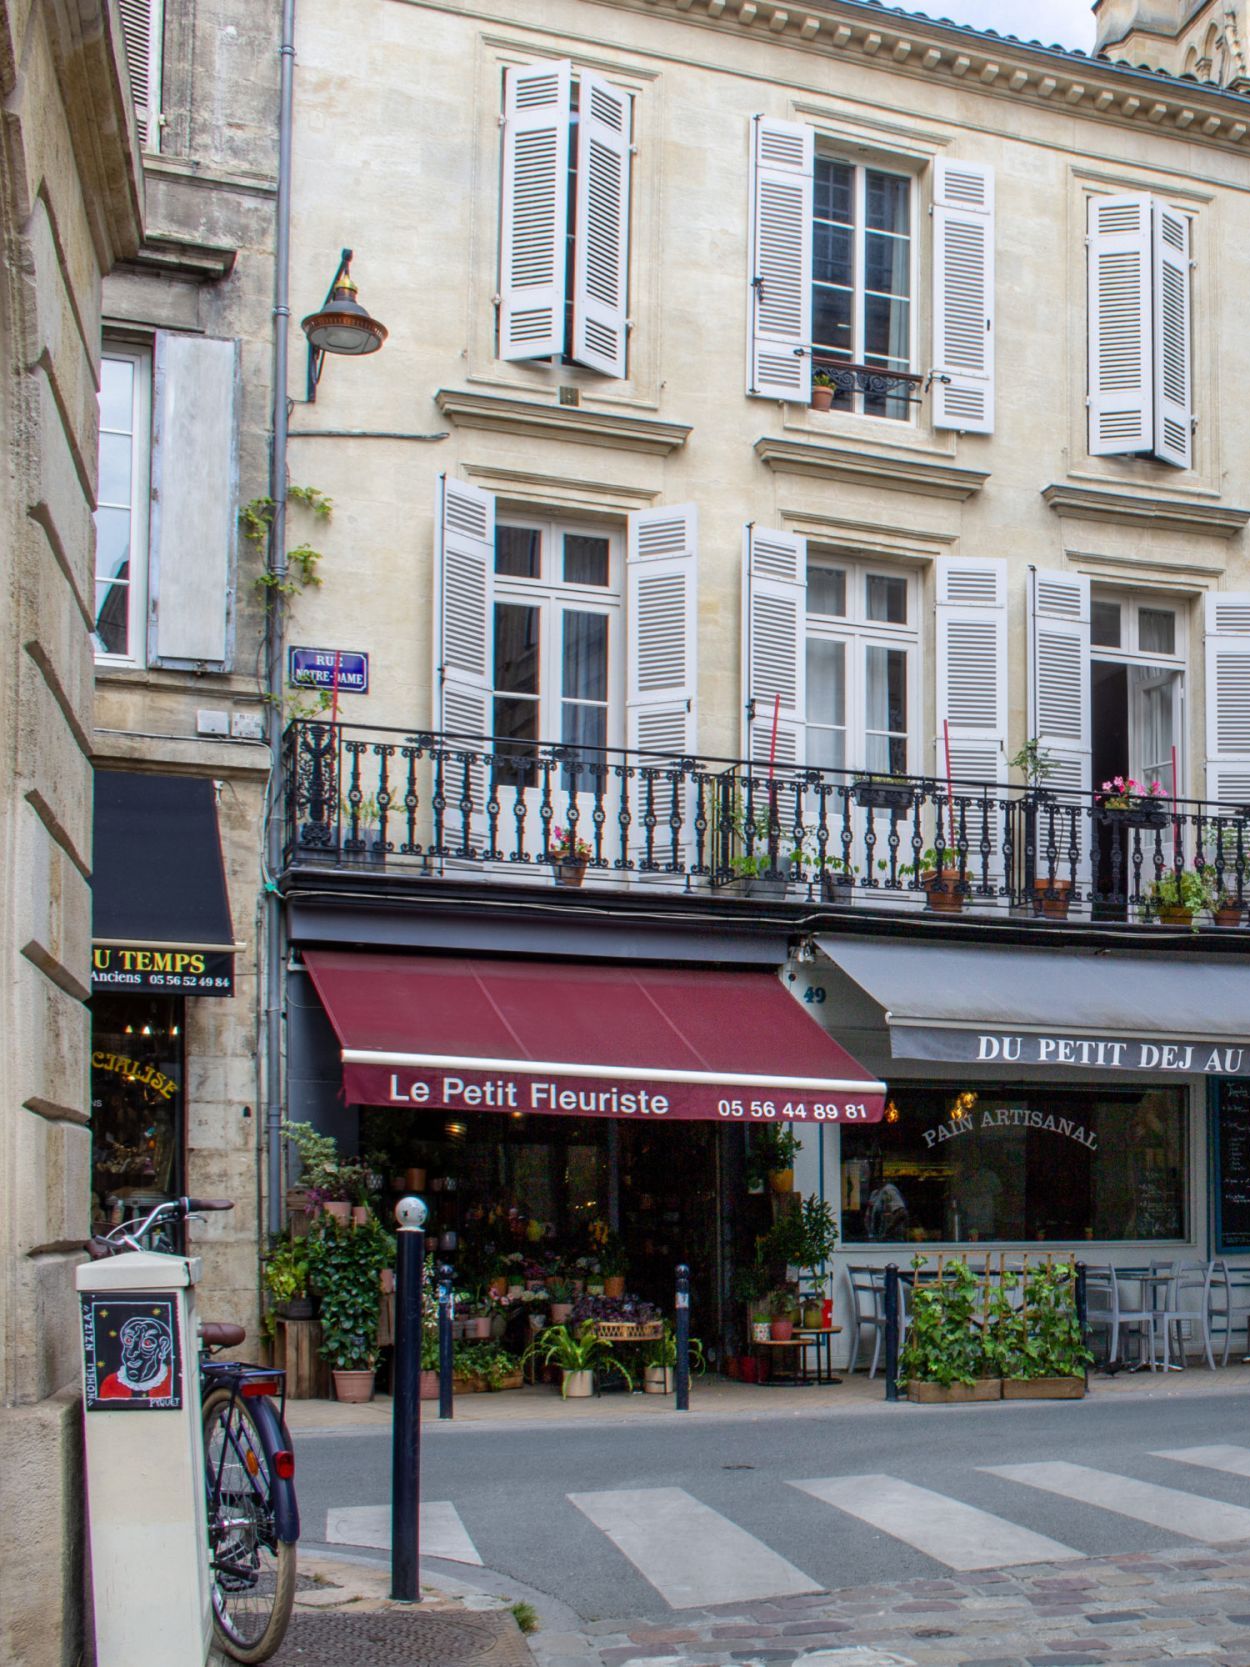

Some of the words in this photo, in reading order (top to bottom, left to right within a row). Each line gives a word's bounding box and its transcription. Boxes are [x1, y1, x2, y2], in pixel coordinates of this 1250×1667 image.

[119, 951, 206, 974] TEMPS
[91, 971, 141, 984] Anciens
[150, 974, 164, 985] 05
[166, 975, 181, 986] 56
[183, 976, 197, 986] 52
[199, 977, 213, 988] 49
[215, 977, 230, 988] 84
[803, 986, 827, 1004] 49
[976, 1035, 1023, 1061] DU
[1037, 1037, 1127, 1066] PETIT
[1137, 1043, 1195, 1070] DEJ
[1204, 1047, 1244, 1073] AU
[389, 1074, 430, 1102] Le
[442, 1077, 518, 1107] Petit
[530, 1082, 669, 1115] Fleuriste
[718, 1100, 744, 1117] 05
[750, 1101, 776, 1118] 56
[782, 1102, 807, 1119] 44
[813, 1103, 839, 1120] 89
[845, 1104, 867, 1119] 81
[921, 1113, 975, 1149] PAIN
[980, 1109, 1099, 1151] ARTISANAL
